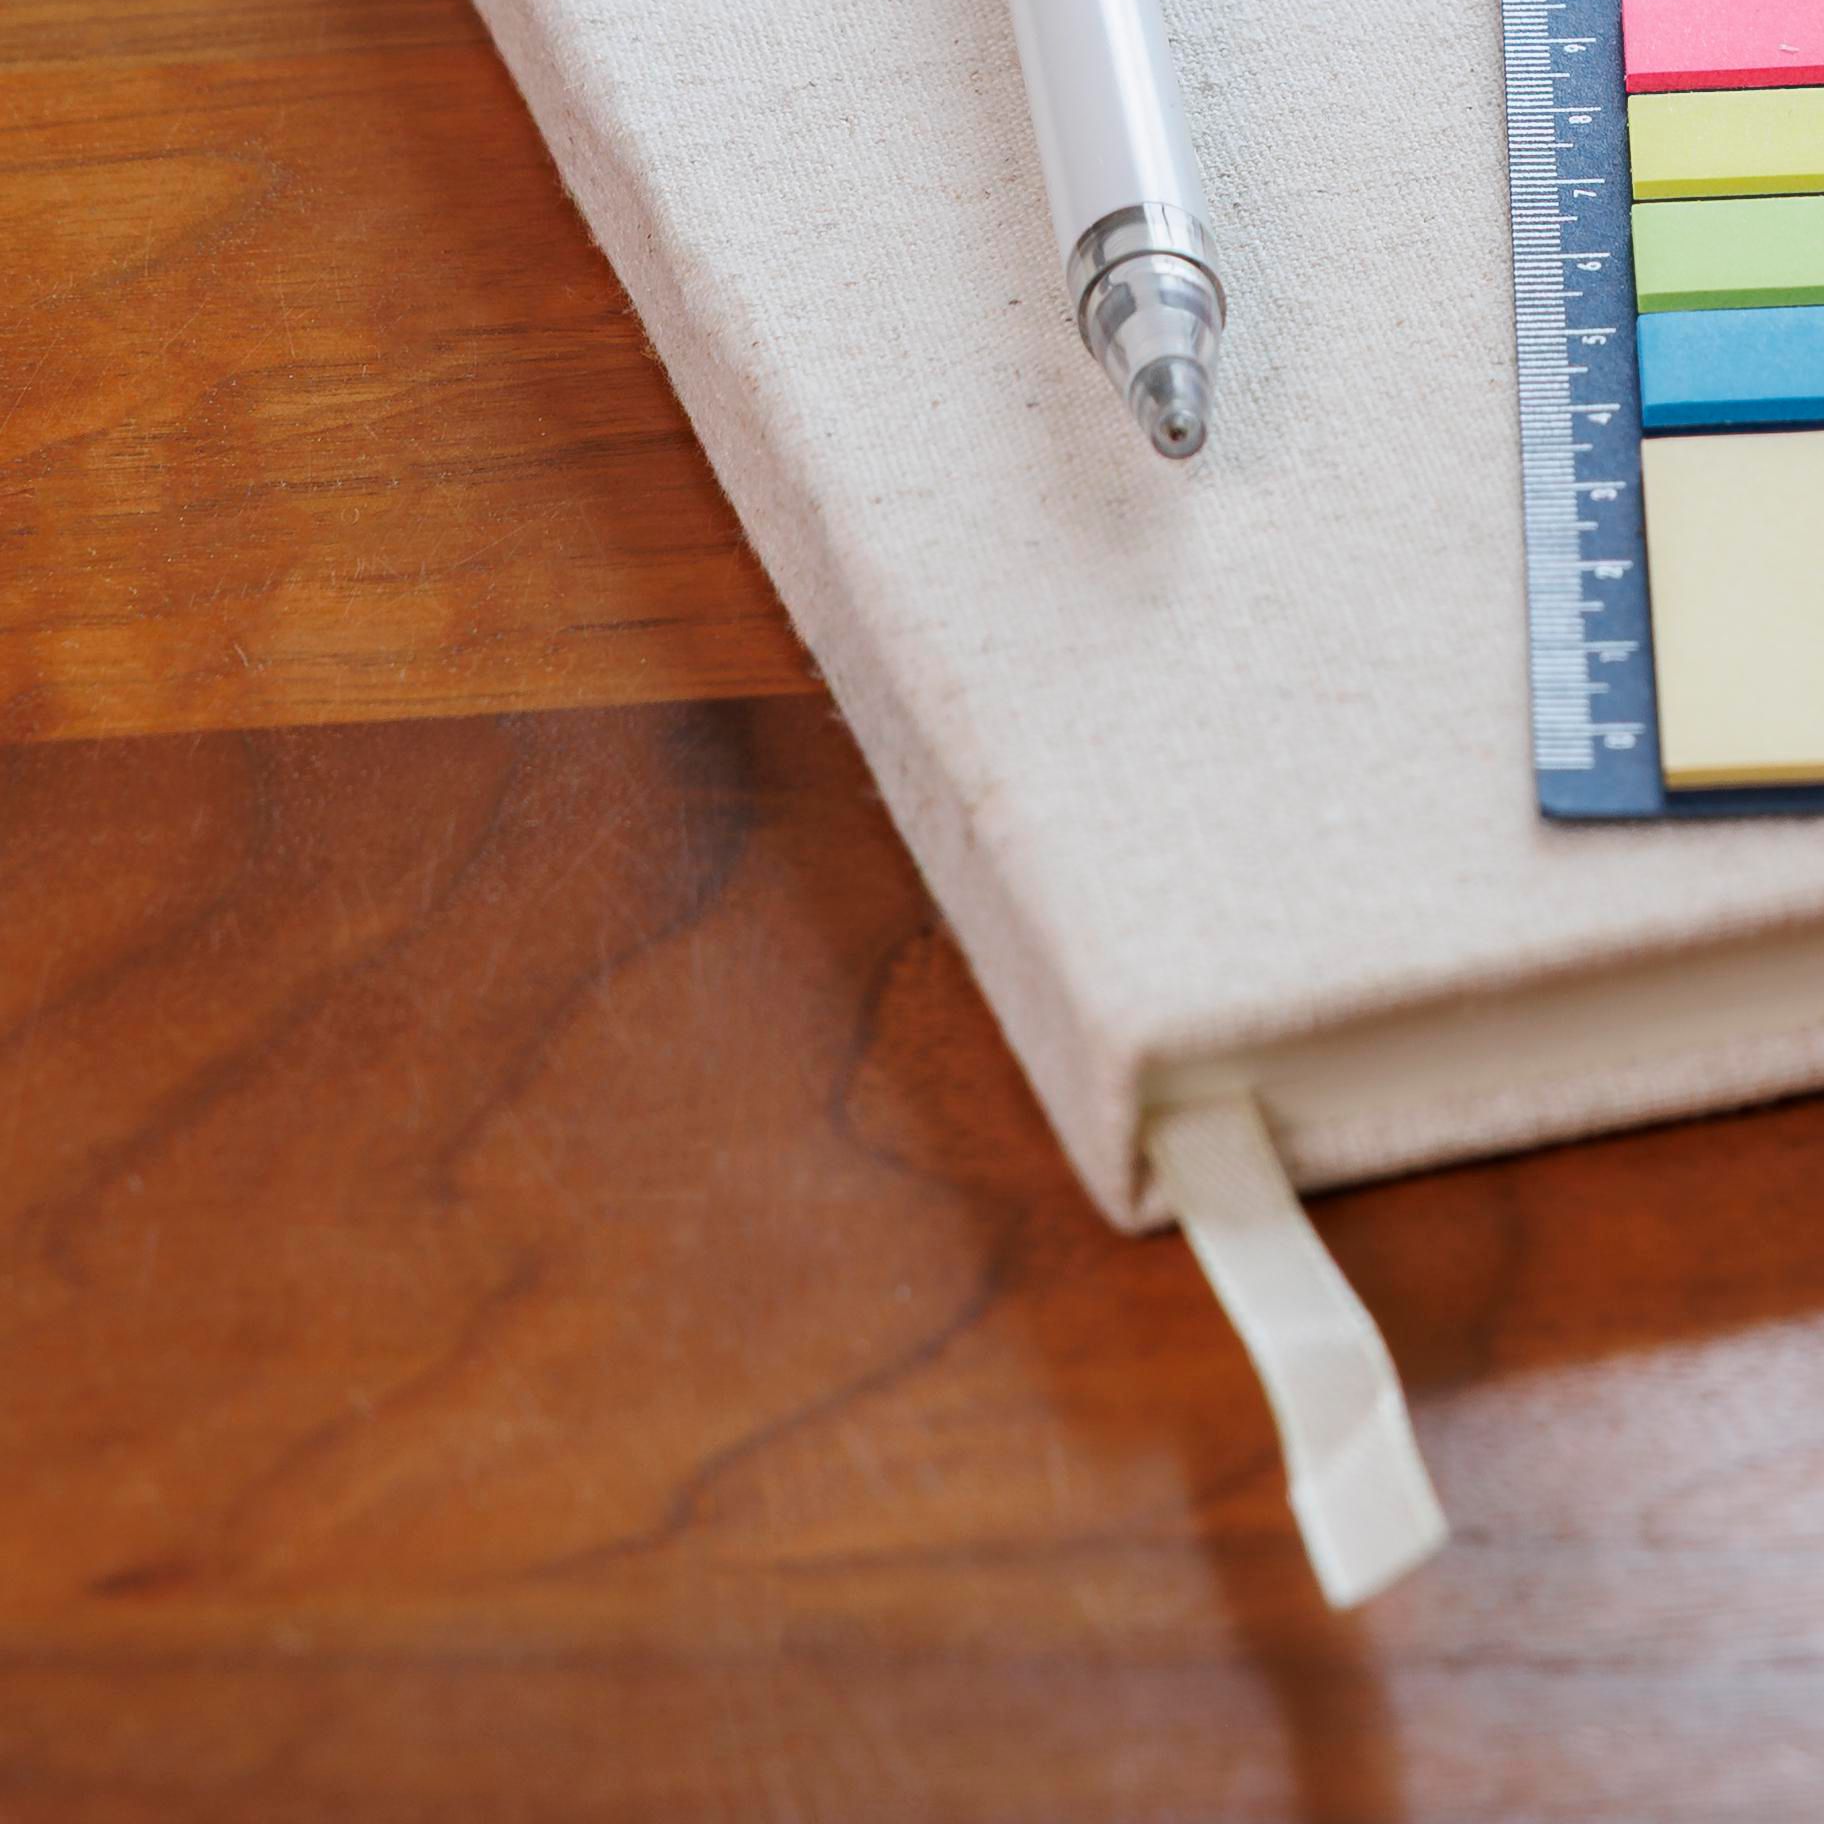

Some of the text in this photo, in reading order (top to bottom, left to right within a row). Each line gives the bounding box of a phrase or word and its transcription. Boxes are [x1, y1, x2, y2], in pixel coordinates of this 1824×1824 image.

[1562, 42, 1588, 54] 9
[1567, 113, 1594, 125] 8
[1573, 188, 1598, 199] 7
[1575, 259, 1603, 273] 6
[1580, 334, 1608, 346] 5
[1586, 411, 1613, 426] 4
